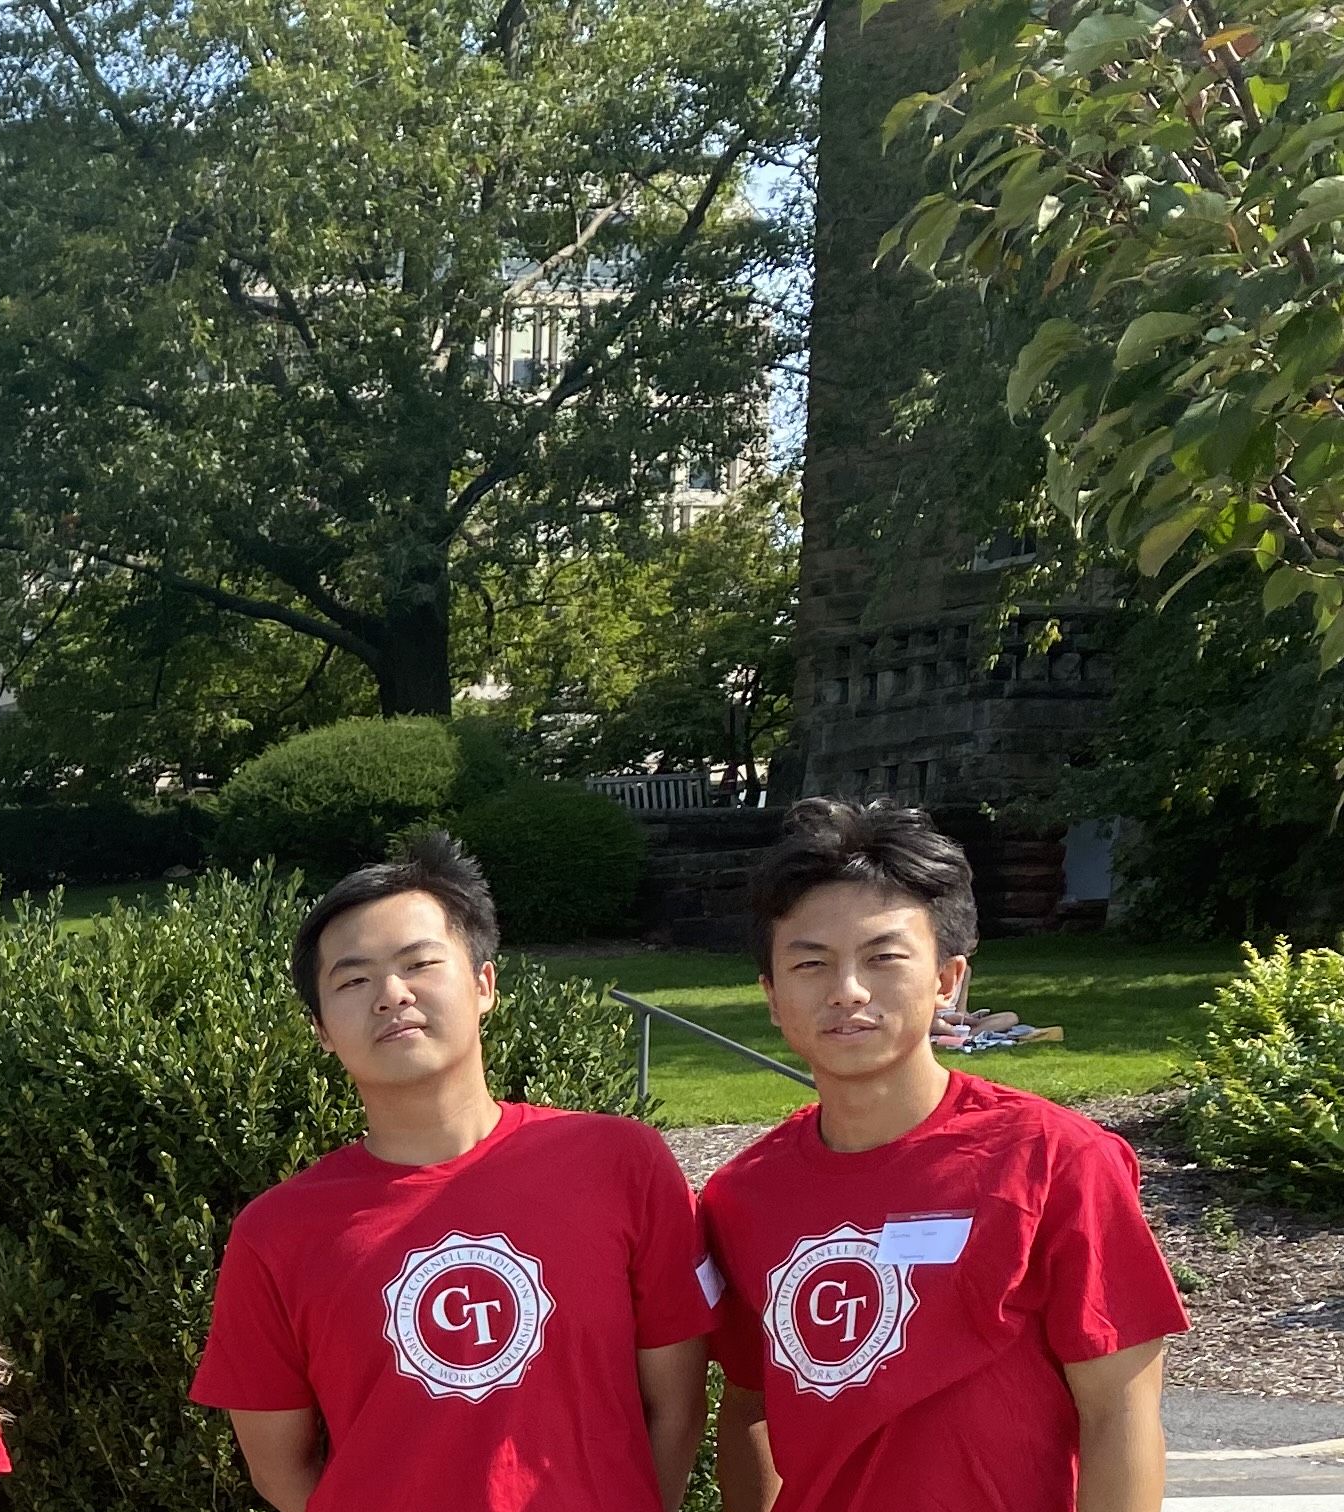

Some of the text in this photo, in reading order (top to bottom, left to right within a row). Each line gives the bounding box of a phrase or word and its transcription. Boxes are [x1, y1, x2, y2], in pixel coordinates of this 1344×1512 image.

[400, 1249, 533, 1320] THE CORNELL TRADITION
[778, 1284, 793, 1309] THE
[791, 1244, 851, 1287] CORNELL
[431, 1284, 502, 1346] CT
[808, 1280, 867, 1343] CT
[836, 1305, 896, 1379] SCHOLARSHIP
[402, 1330, 476, 1384] SERVICE WORK
[478, 1309, 535, 1381] SCHOLARSHIP
